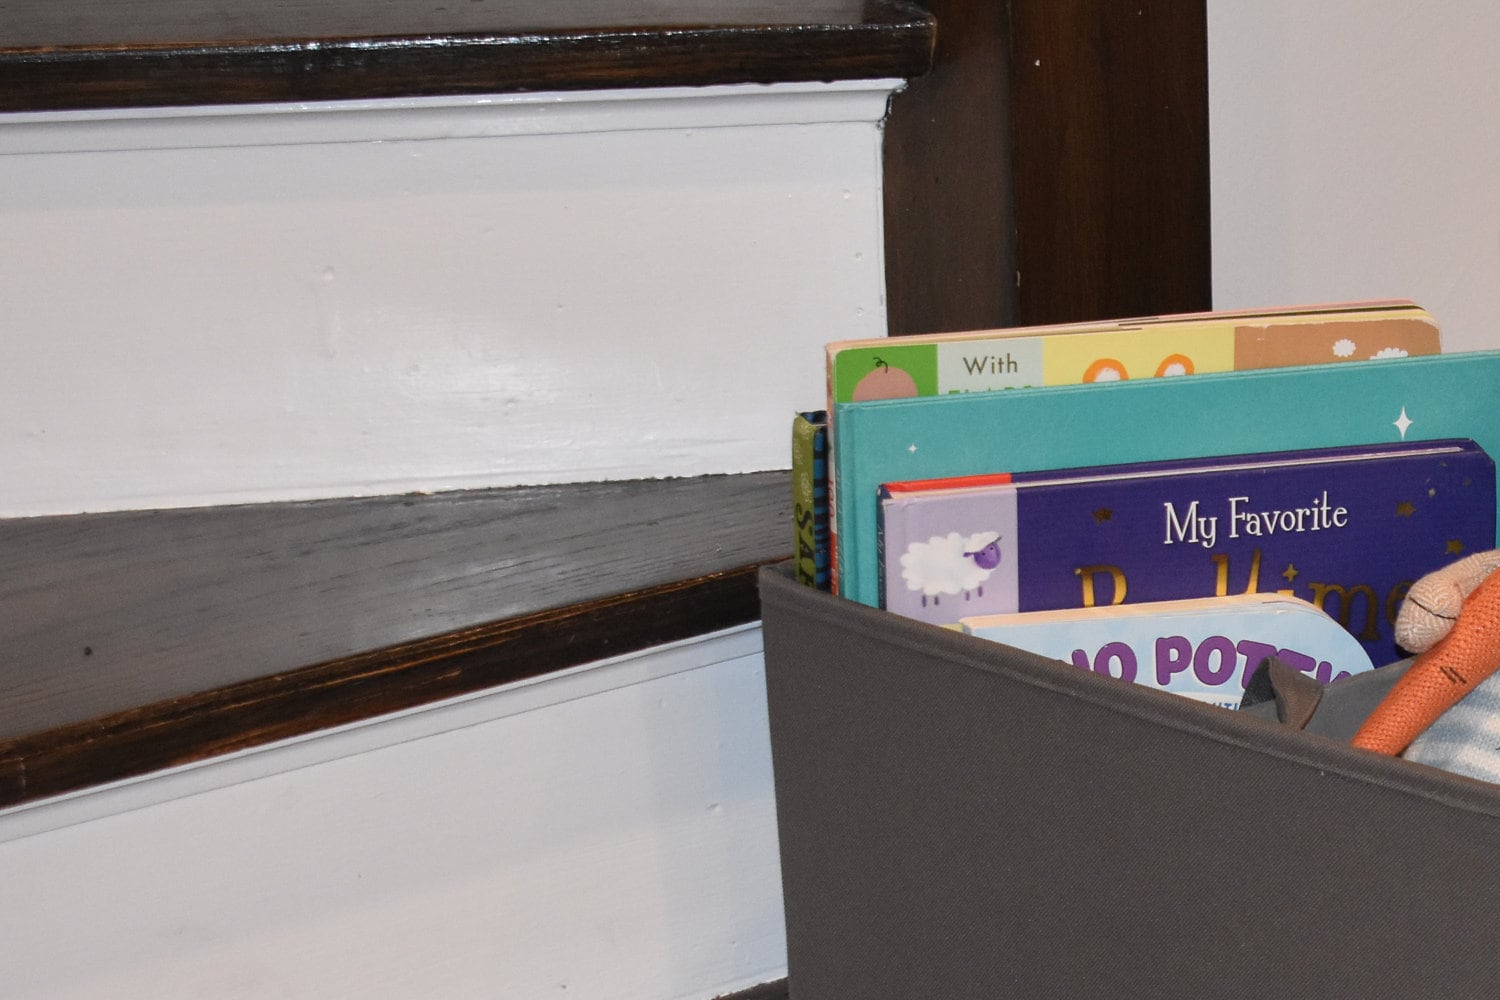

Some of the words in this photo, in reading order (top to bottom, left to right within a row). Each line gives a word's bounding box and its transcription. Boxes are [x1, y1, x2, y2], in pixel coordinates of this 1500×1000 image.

[963, 352, 1018, 376] With
[1163, 500, 1218, 548] My
[1228, 490, 1348, 538] Favorite
[1058, 641, 1138, 684] O
